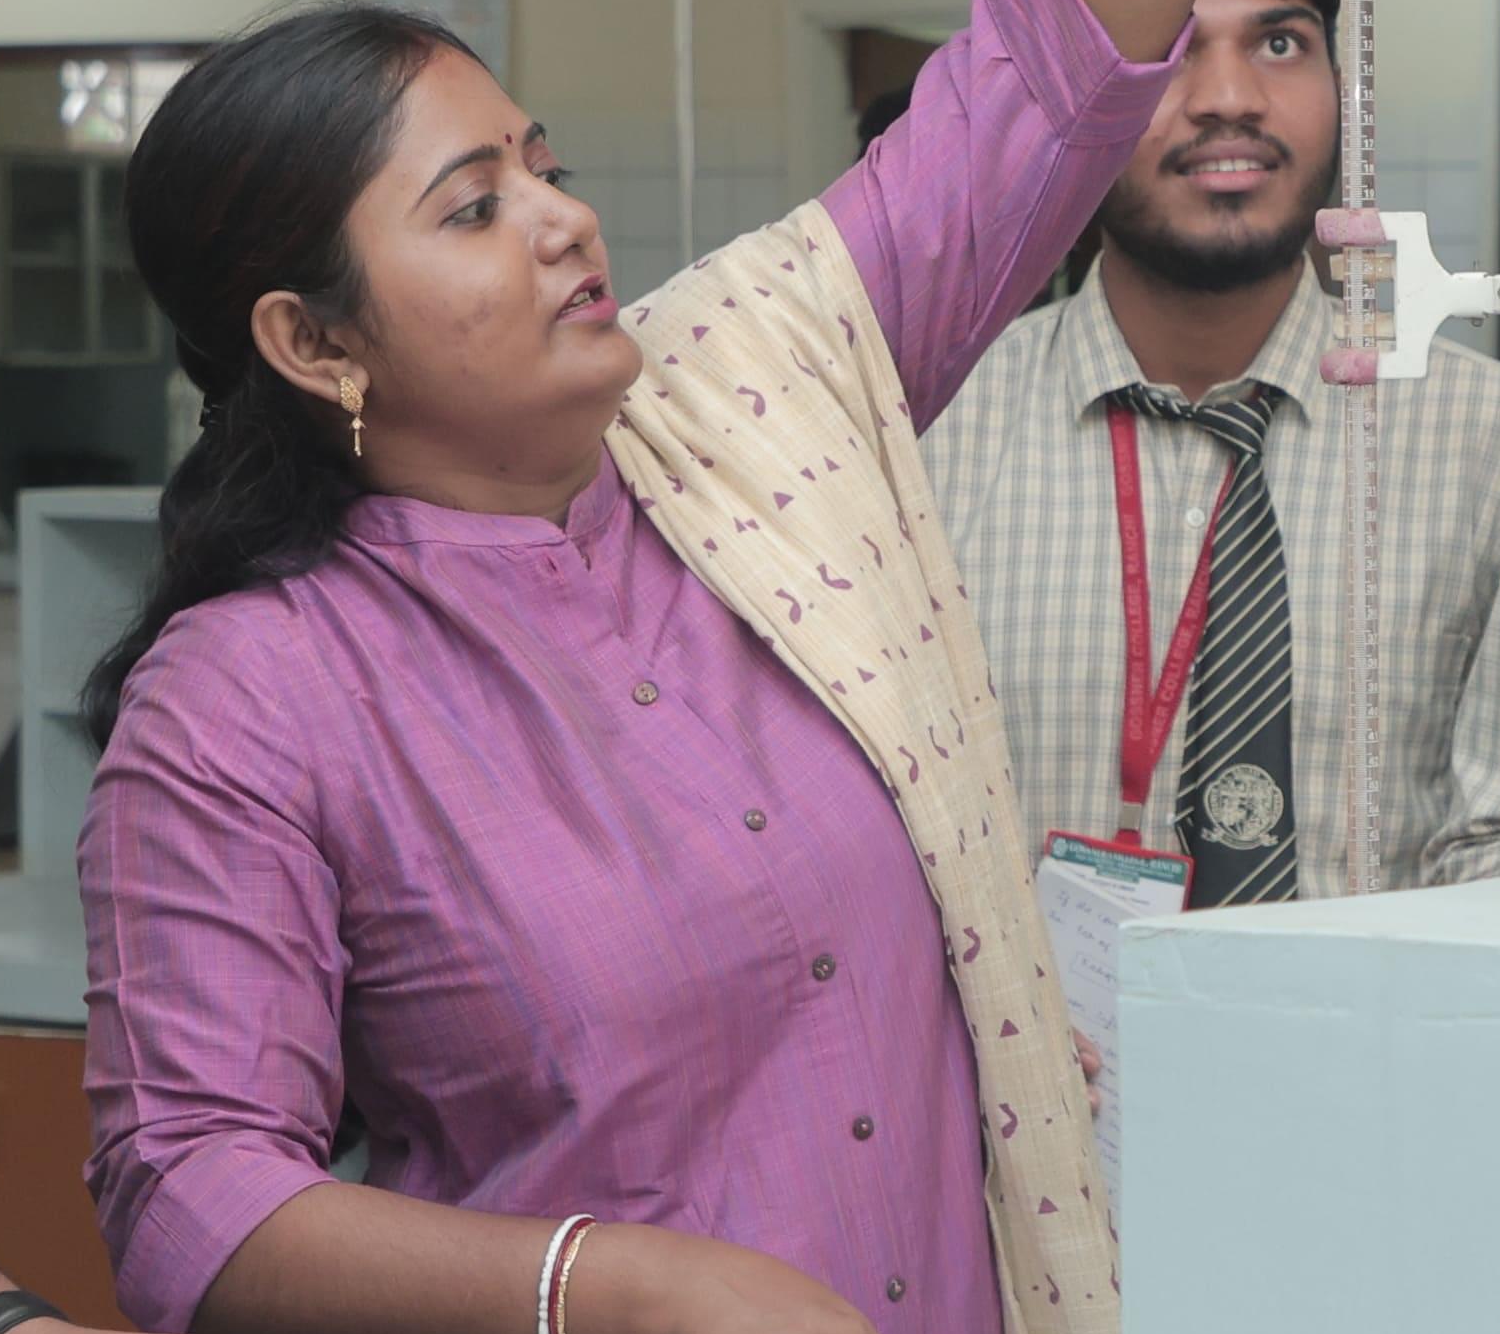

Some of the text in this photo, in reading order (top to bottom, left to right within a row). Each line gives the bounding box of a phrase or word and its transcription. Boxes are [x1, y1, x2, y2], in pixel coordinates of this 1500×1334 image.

[1363, 15, 1372, 24] 12
[1364, 64, 1373, 74] 14
[1364, 89, 1373, 99] 15
[1364, 114, 1373, 124] 16
[1364, 138, 1373, 148] 17
[1364, 188, 1374, 198] 19
[1159, 621, 1196, 701] COLLEGE,
[1129, 662, 1143, 741] GOSSNER
